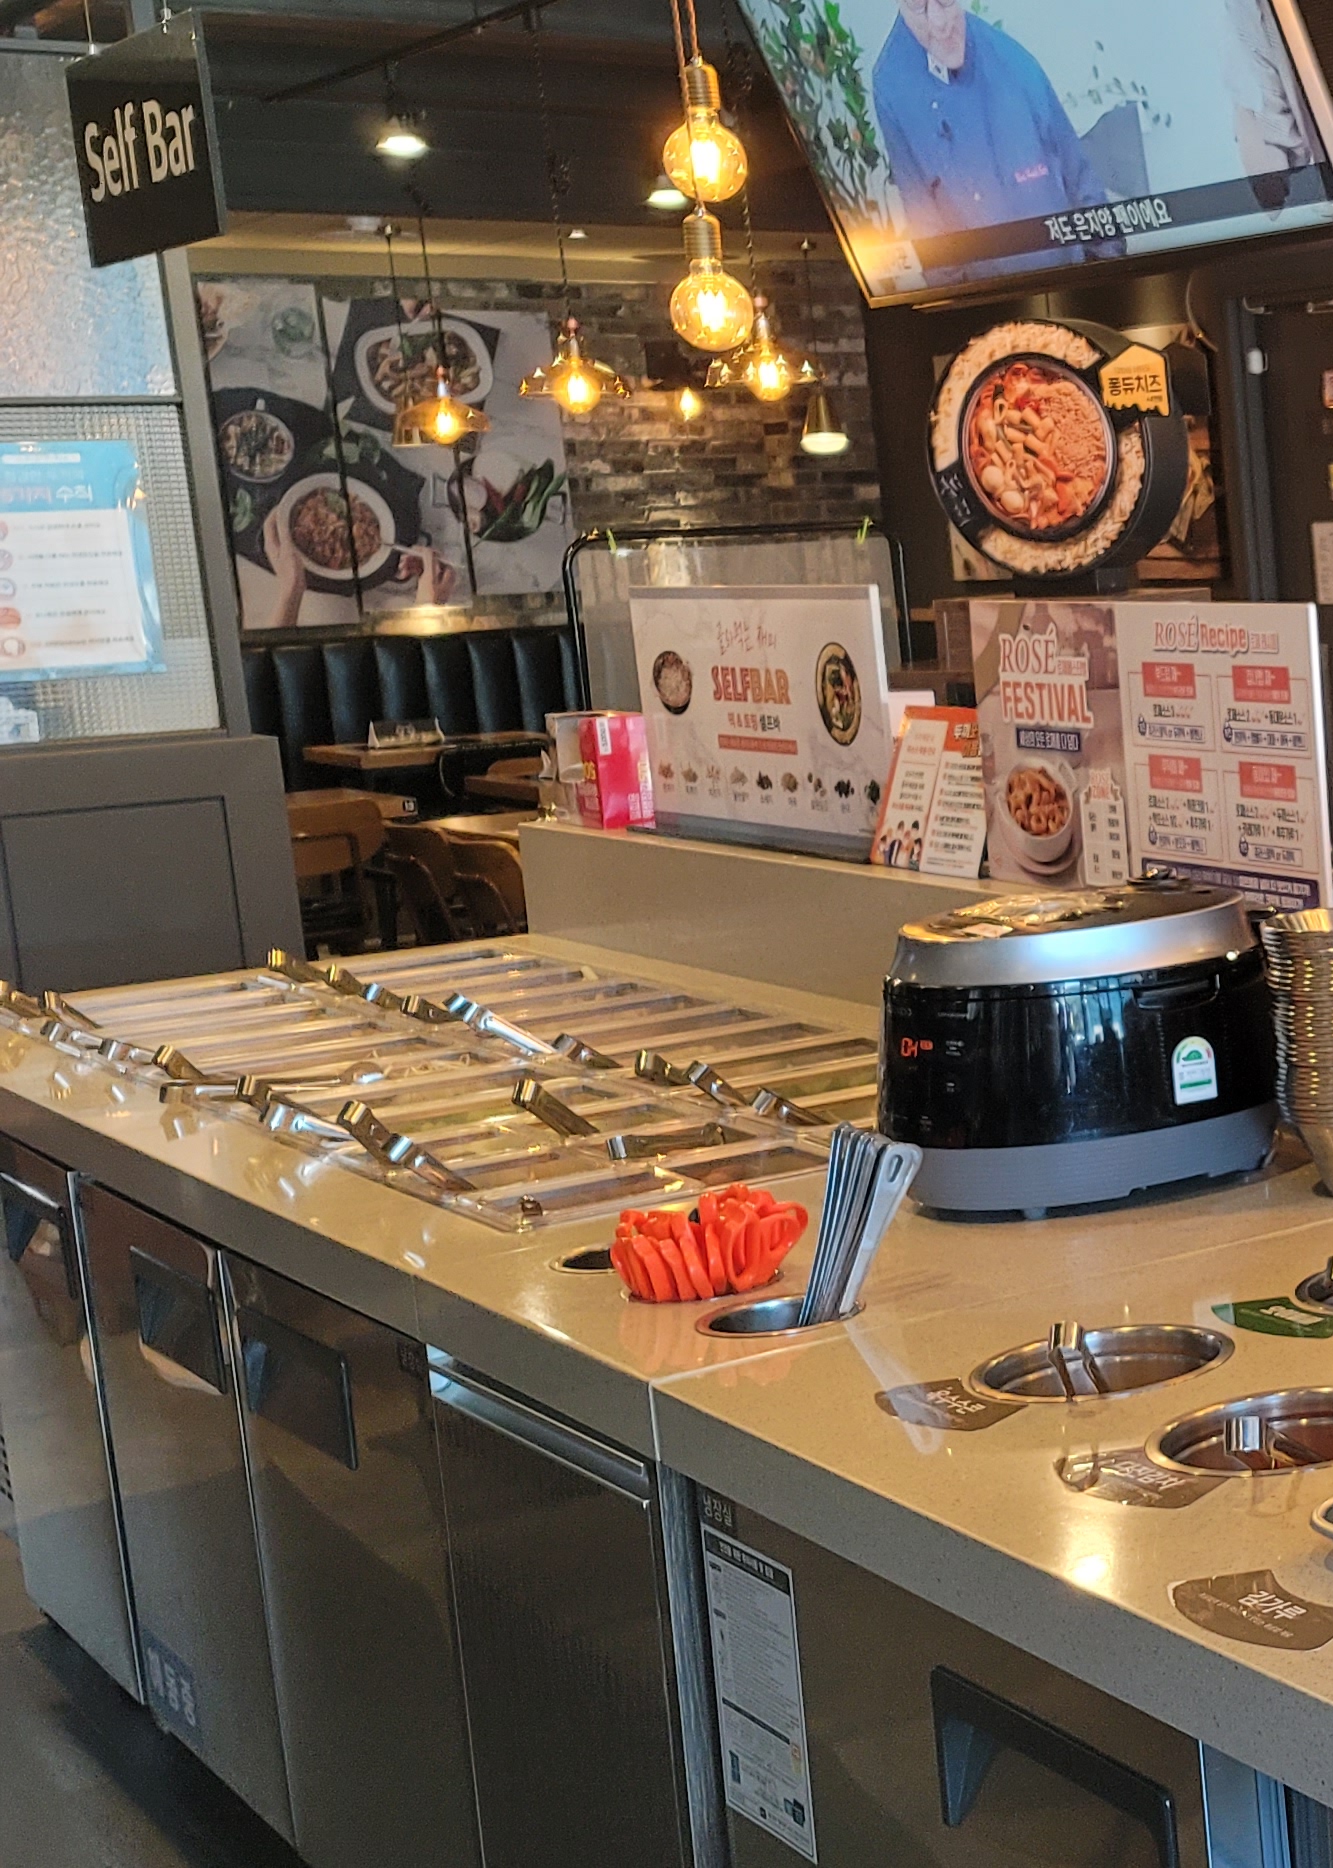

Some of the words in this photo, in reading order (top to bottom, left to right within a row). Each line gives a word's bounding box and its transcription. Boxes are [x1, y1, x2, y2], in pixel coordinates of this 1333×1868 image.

[84, 102, 139, 202] Self
[142, 100, 195, 183] Bar
[1108, 374, 1162, 396] 퐁듀치즈
[1001, 625, 1056, 674] ROSÉ
[1155, 616, 1196, 647] ROSÉ
[1200, 623, 1248, 651] Recipe
[1002, 681, 1092, 724] FESTIVAL
[703, 1494, 733, 1527] 냉장실
[1238, 1590, 1307, 1620] 김가루
